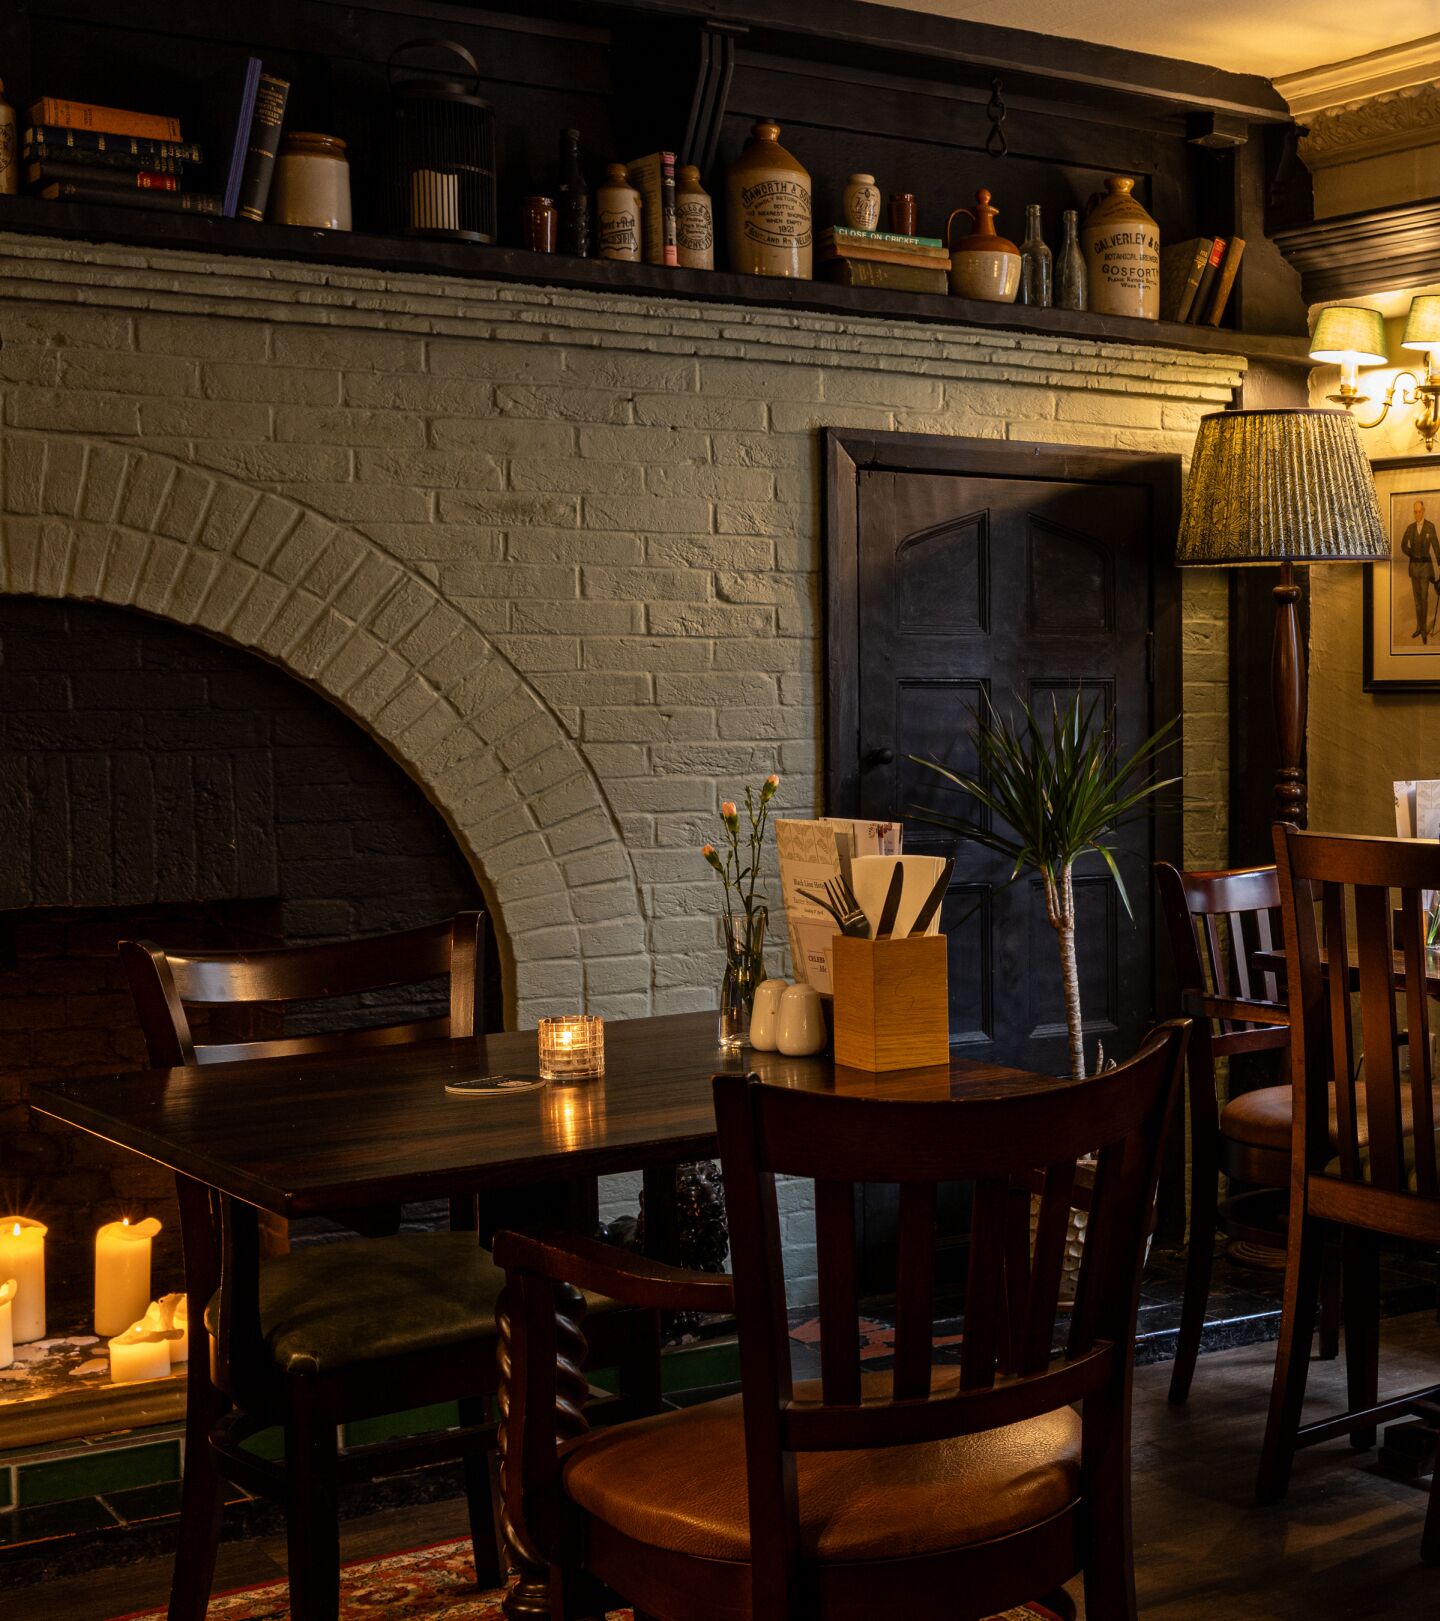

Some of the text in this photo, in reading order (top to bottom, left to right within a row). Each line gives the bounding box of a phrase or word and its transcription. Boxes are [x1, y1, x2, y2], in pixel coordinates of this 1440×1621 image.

[742, 182, 787, 204] HAWORTH
[791, 184, 797, 194] &
[776, 196, 798, 204] RETURN
[838, 228, 920, 245] CLOSE ON CRICKET
[1094, 232, 1146, 254] CALVERLEY
[1148, 237, 1153, 248] &
